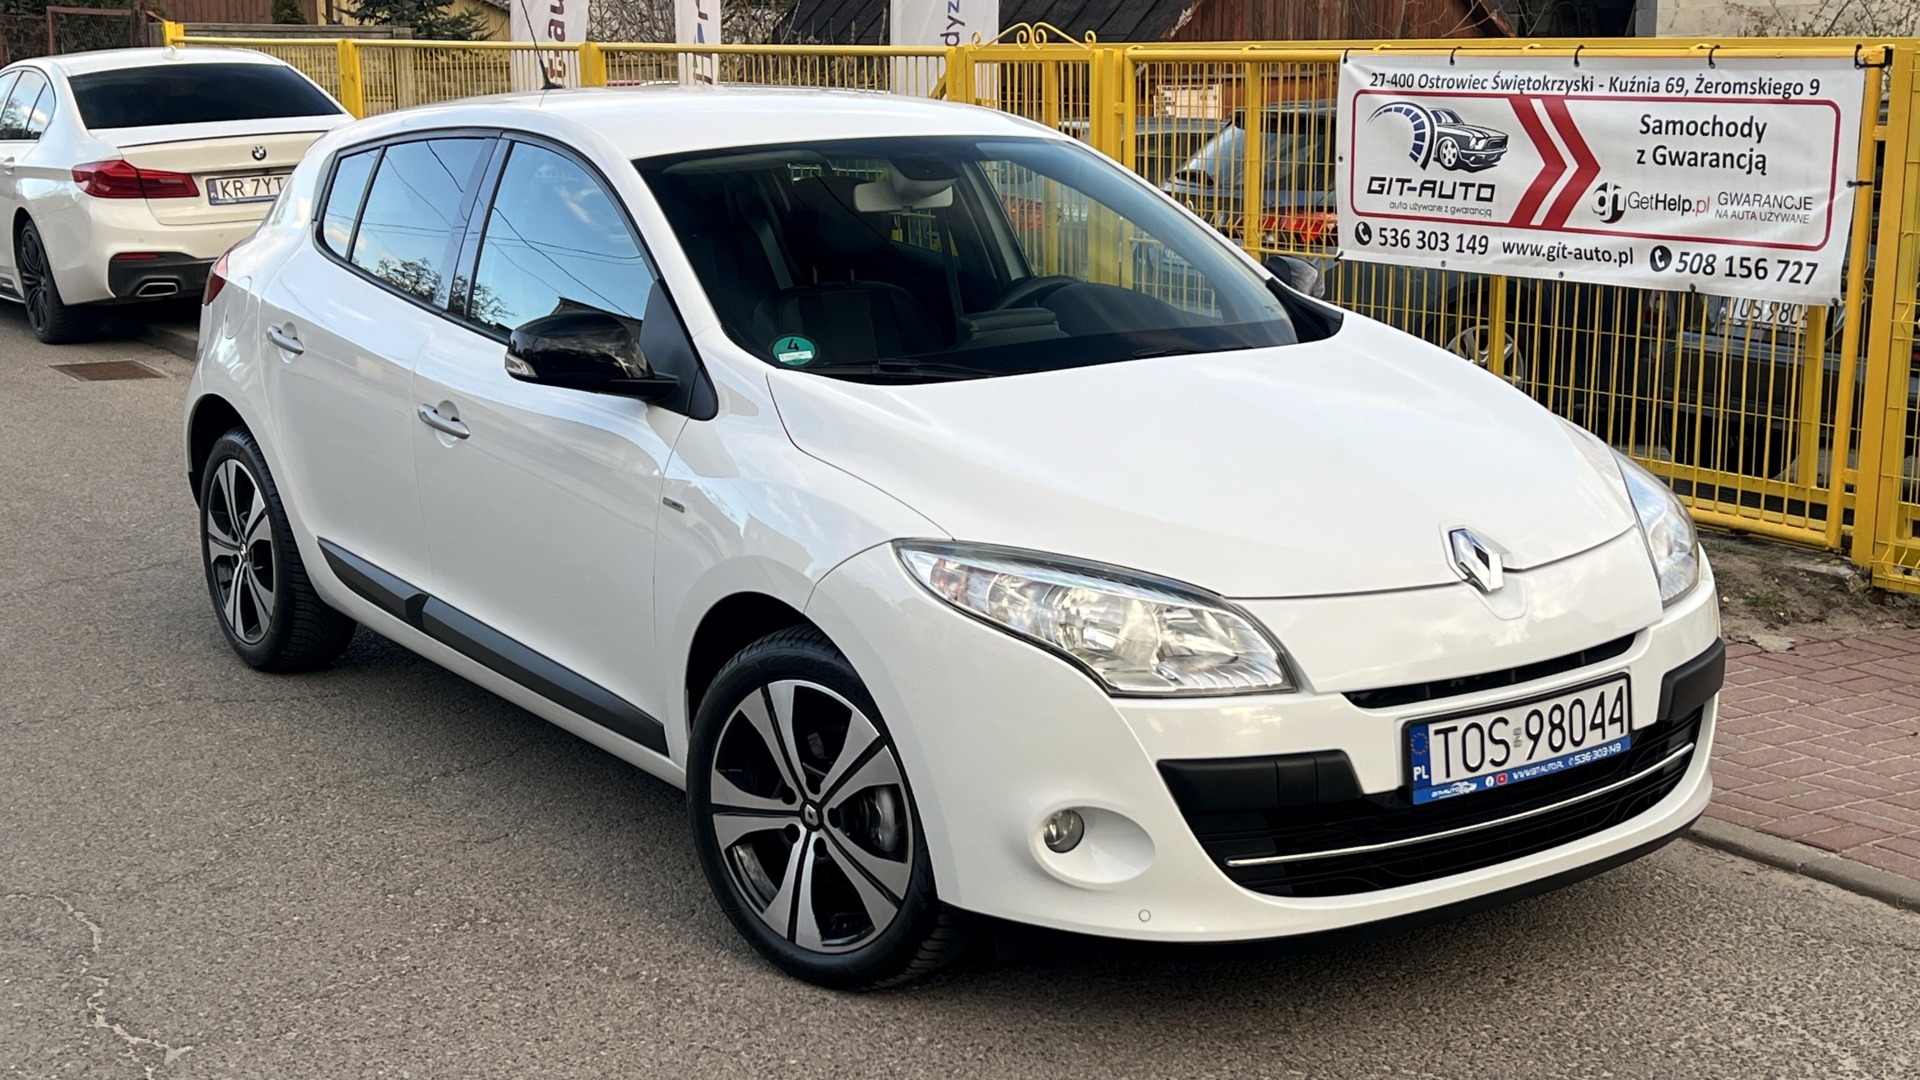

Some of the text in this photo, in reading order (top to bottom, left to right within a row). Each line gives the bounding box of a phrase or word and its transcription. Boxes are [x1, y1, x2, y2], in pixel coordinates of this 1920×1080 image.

[1370, 72, 1414, 88] 27-400
[1418, 73, 1488, 90] Ostrowiec
[1491, 71, 1594, 95] Świętokrzyski
[1609, 76, 1660, 94] Kuźnia
[1665, 77, 1689, 97] 69,
[1694, 73, 1804, 99] Żeromskiego
[1809, 78, 1820, 96] 9
[1639, 114, 1767, 144] Samochody
[1636, 145, 1767, 176] z Gwarancją
[220, 177, 283, 198] KR 7YT
[1367, 176, 1496, 202] GIT-AUTO
[1628, 191, 1710, 217] GetHelp.pl
[1717, 191, 1813, 211] GWARANCJE
[1715, 208, 1728, 219] NA
[1730, 210, 1757, 221] AUTA
[1378, 227, 1489, 256] 536 303 149
[1502, 240, 1633, 267] www.git-auto.pl
[1675, 251, 1819, 285] 508 156 727
[787, 337, 800, 351] 4
[1434, 685, 1624, 779] TOS 98044
[1574, 742, 1622, 765] 536-303-149
[1413, 765, 1430, 781] PL
